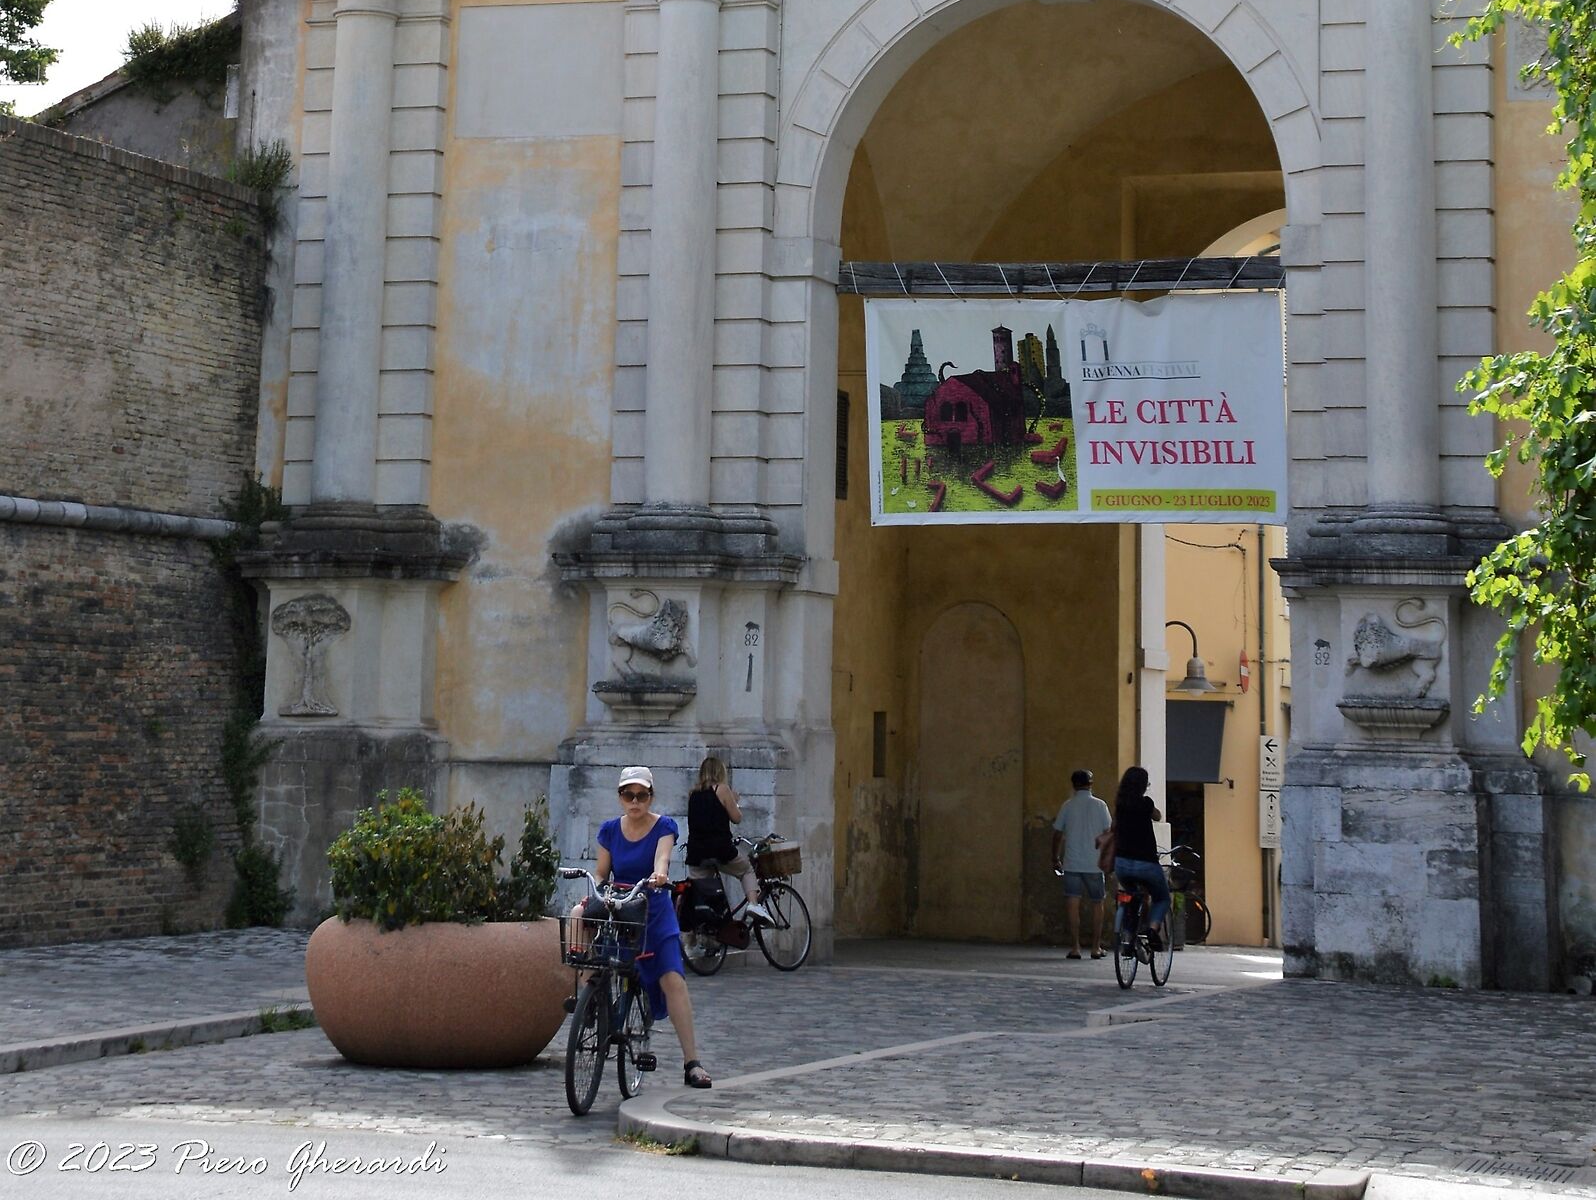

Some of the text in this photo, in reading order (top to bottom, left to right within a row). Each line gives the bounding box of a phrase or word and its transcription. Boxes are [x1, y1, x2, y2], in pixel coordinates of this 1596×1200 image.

[1085, 391, 1238, 425] LE CITTÀ
[1088, 440, 1257, 465] INVISIBILI
[1095, 495, 1102, 507] 7
[1105, 494, 1162, 507] GIUGNO
[1173, 494, 1187, 507] 23
[1189, 494, 1243, 507] LUGLIO
[1246, 495, 1271, 508] 2023
[744, 633, 759, 647] 82
[1314, 651, 1330, 666] 82
